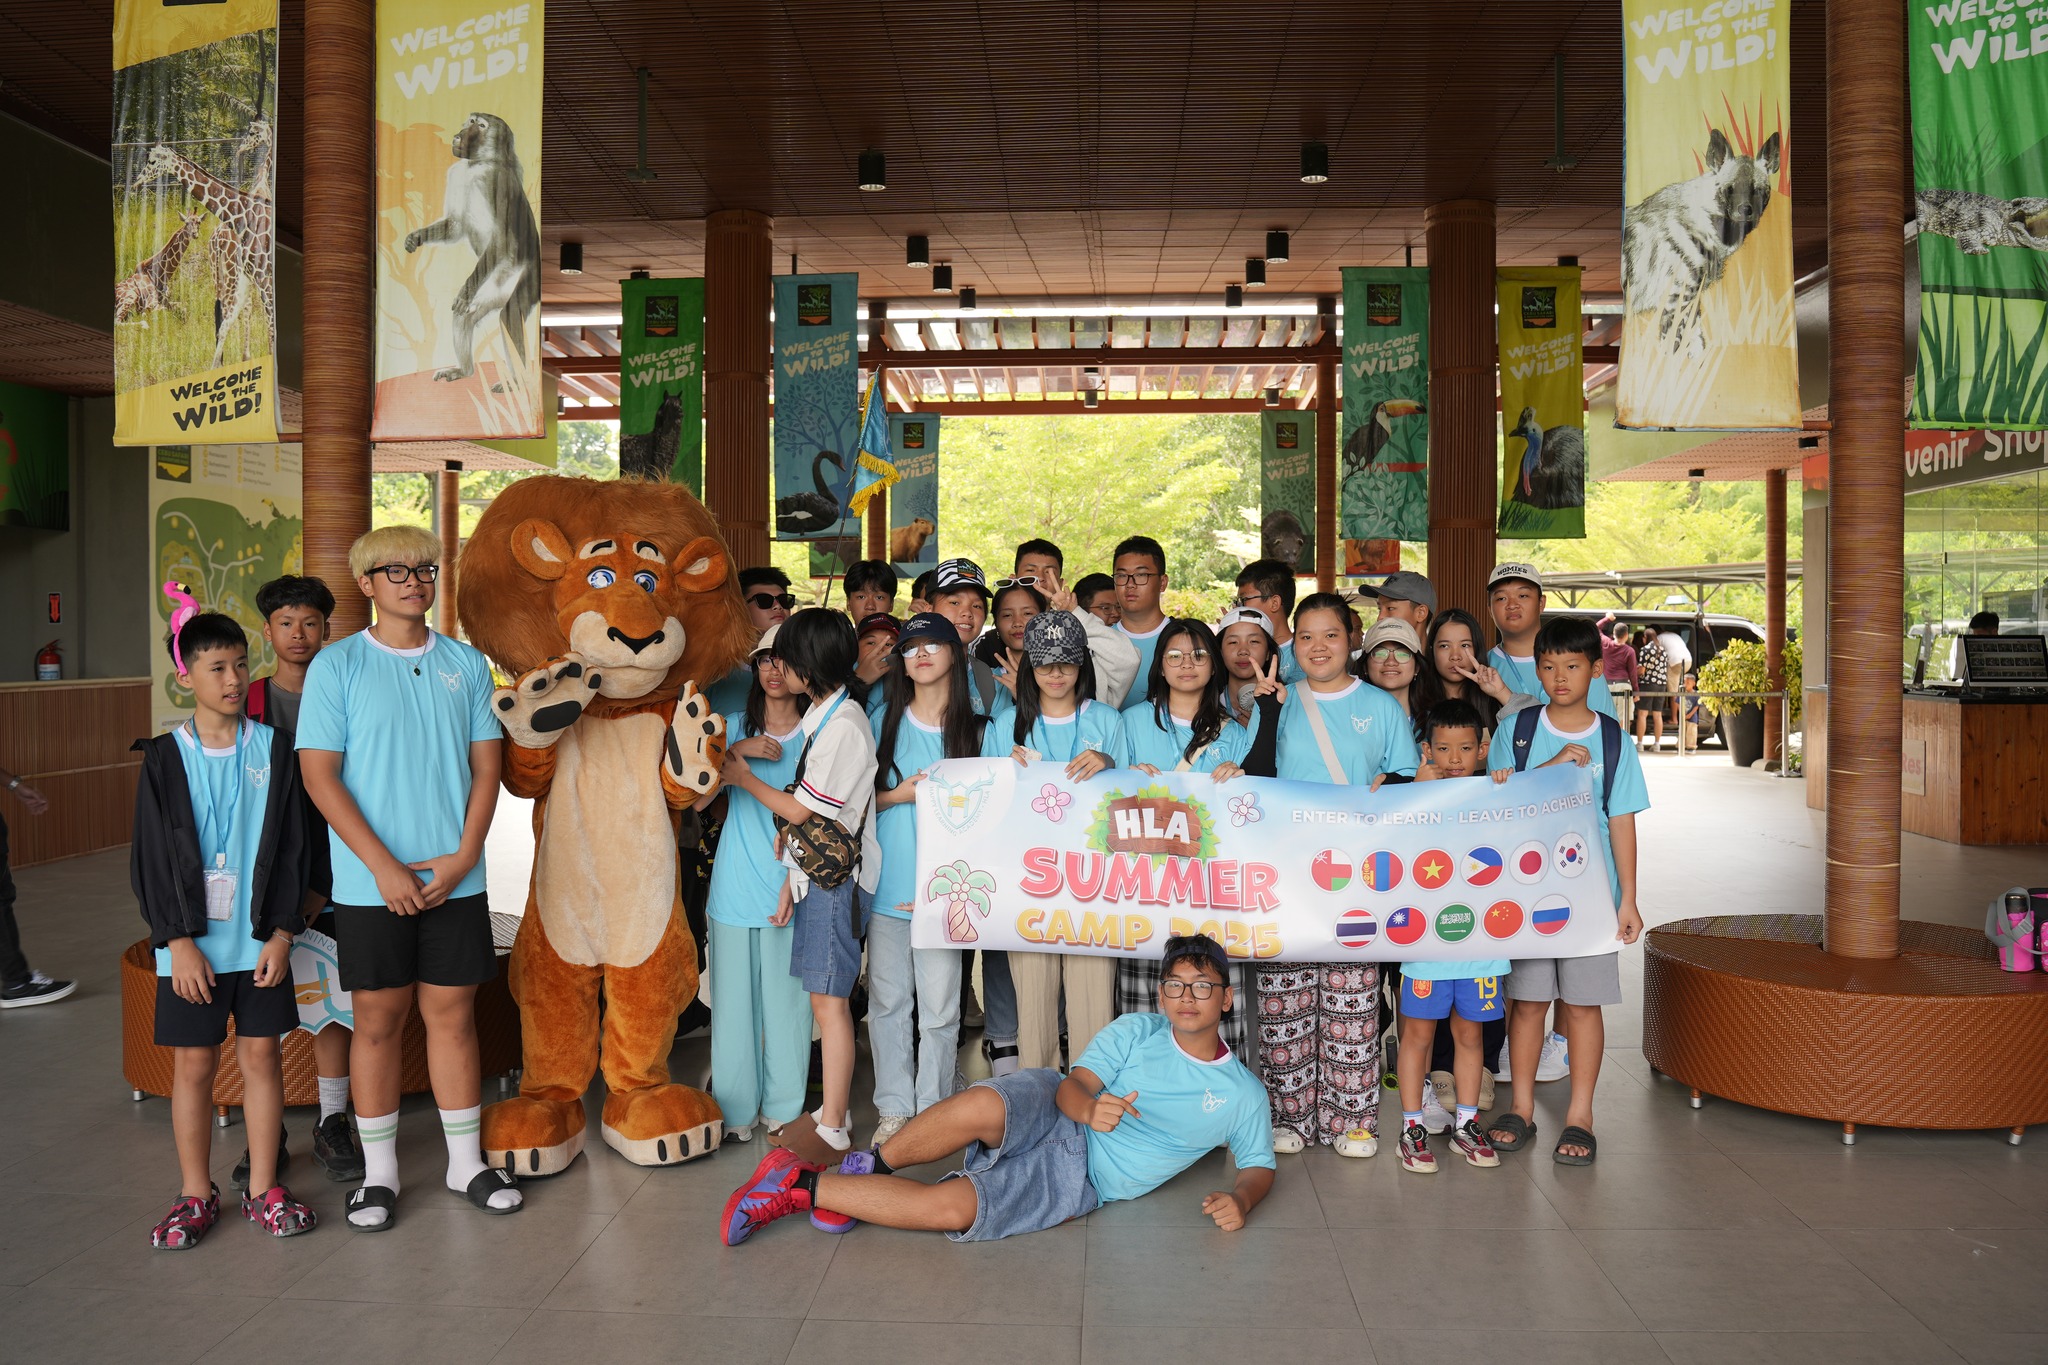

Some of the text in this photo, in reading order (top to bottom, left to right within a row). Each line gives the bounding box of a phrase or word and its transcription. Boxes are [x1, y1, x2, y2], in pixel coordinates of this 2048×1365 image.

[390, 3, 530, 57] WELCOME
[1694, 12, 1770, 42] TO THE
[1988, 13, 2017, 32] TO
[448, 27, 521, 58] TO THE
[1634, 28, 1776, 84] WILD!
[394, 43, 529, 100] WILD!
[628, 343, 696, 368] WELCOME
[781, 331, 850, 357] WELCOME
[810, 343, 846, 357] TO THE
[1348, 332, 1420, 357] WELCOME
[1379, 344, 1416, 358] TO THE
[1506, 332, 1575, 359] WELCOME
[1536, 344, 1571, 360] TO THE
[629, 361, 695, 388] WILD!
[656, 354, 692, 369] TO THE
[783, 350, 850, 378] WILD!
[1350, 351, 1420, 378] WILD!
[1509, 352, 1575, 381] WILD!
[170, 366, 262, 401] WELCOME
[209, 382, 256, 403] TO THE
[173, 392, 262, 431] WILD!
[1984, 430, 2048, 464] Sho
[1497, 565, 1528, 576] HOMIES
[1292, 810, 1348, 824] ENTER
[1354, 812, 1378, 825] TO
[1383, 812, 1442, 825] LEARN
[1459, 810, 1514, 824] LEAVE
[1518, 805, 1538, 818] TO
[1541, 791, 1592, 815] ACHIEVE
[1114, 807, 1191, 844] HLA
[1018, 847, 1281, 913] SUMMER
[1015, 908, 1154, 951] CAMP
[1474, 976, 1498, 999] 19
